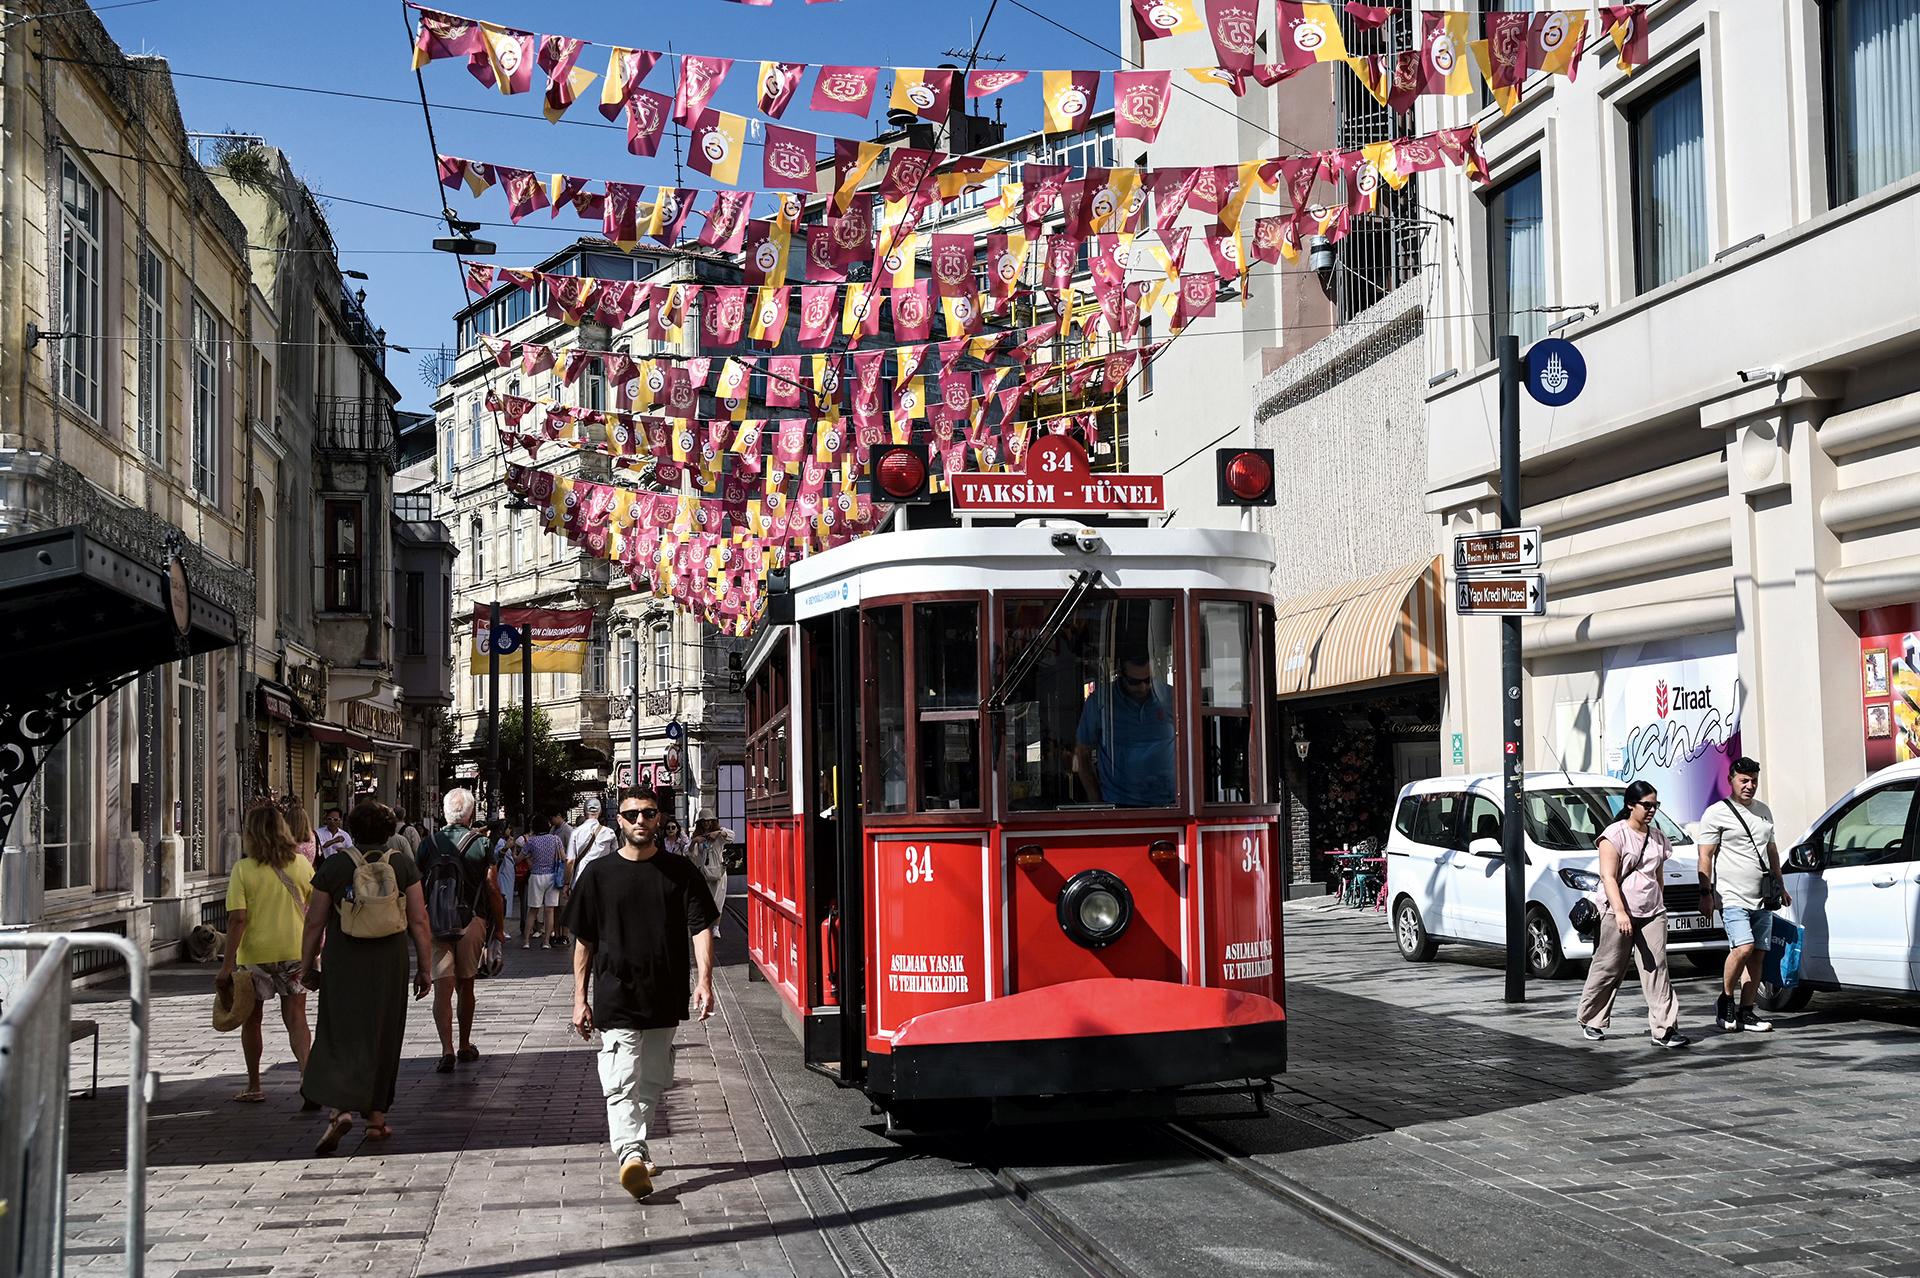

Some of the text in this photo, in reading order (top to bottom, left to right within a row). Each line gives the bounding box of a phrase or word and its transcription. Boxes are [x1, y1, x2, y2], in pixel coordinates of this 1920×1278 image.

[833, 81, 858, 95] 25
[986, 76, 1008, 86] 25
[1132, 96, 1154, 117] 25
[1199, 178, 1216, 194] 25
[843, 219, 857, 238] 25
[728, 306, 740, 321] 25
[810, 304, 823, 321] 25
[903, 303, 917, 319] 25
[511, 402, 522, 413] 25
[941, 422, 950, 434] 25
[788, 435, 799, 447] 25
[865, 431, 877, 444] 25
[951, 461, 960, 471] 25
[1042, 451, 1073, 472] 34
[810, 469, 819, 479] 25
[536, 484, 545, 493] 25
[962, 479, 1055, 503] TAKSİM
[1081, 480, 1158, 504] TÜNEL
[660, 509, 669, 518] 25
[1470, 542, 1487, 552] Türkiye
[1467, 551, 1519, 563] Resim Heykel Müzesi
[1469, 587, 1525, 606] Yapı Kredi Müzesi
[1672, 685, 1712, 711] Ziraat
[1507, 744, 1514, 753] 2
[1242, 837, 1261, 873] 34
[906, 846, 934, 884] 34
[1676, 918, 1691, 929] CHA
[1696, 917, 1711, 928] 180
[1771, 935, 1786, 947] avi
[1225, 941, 1259, 960] ASILMAK
[890, 954, 964, 973] ASILMAK YASAK
[1223, 964, 1235, 980] VE
[888, 974, 969, 993] VE TEHLIKELIDIR
